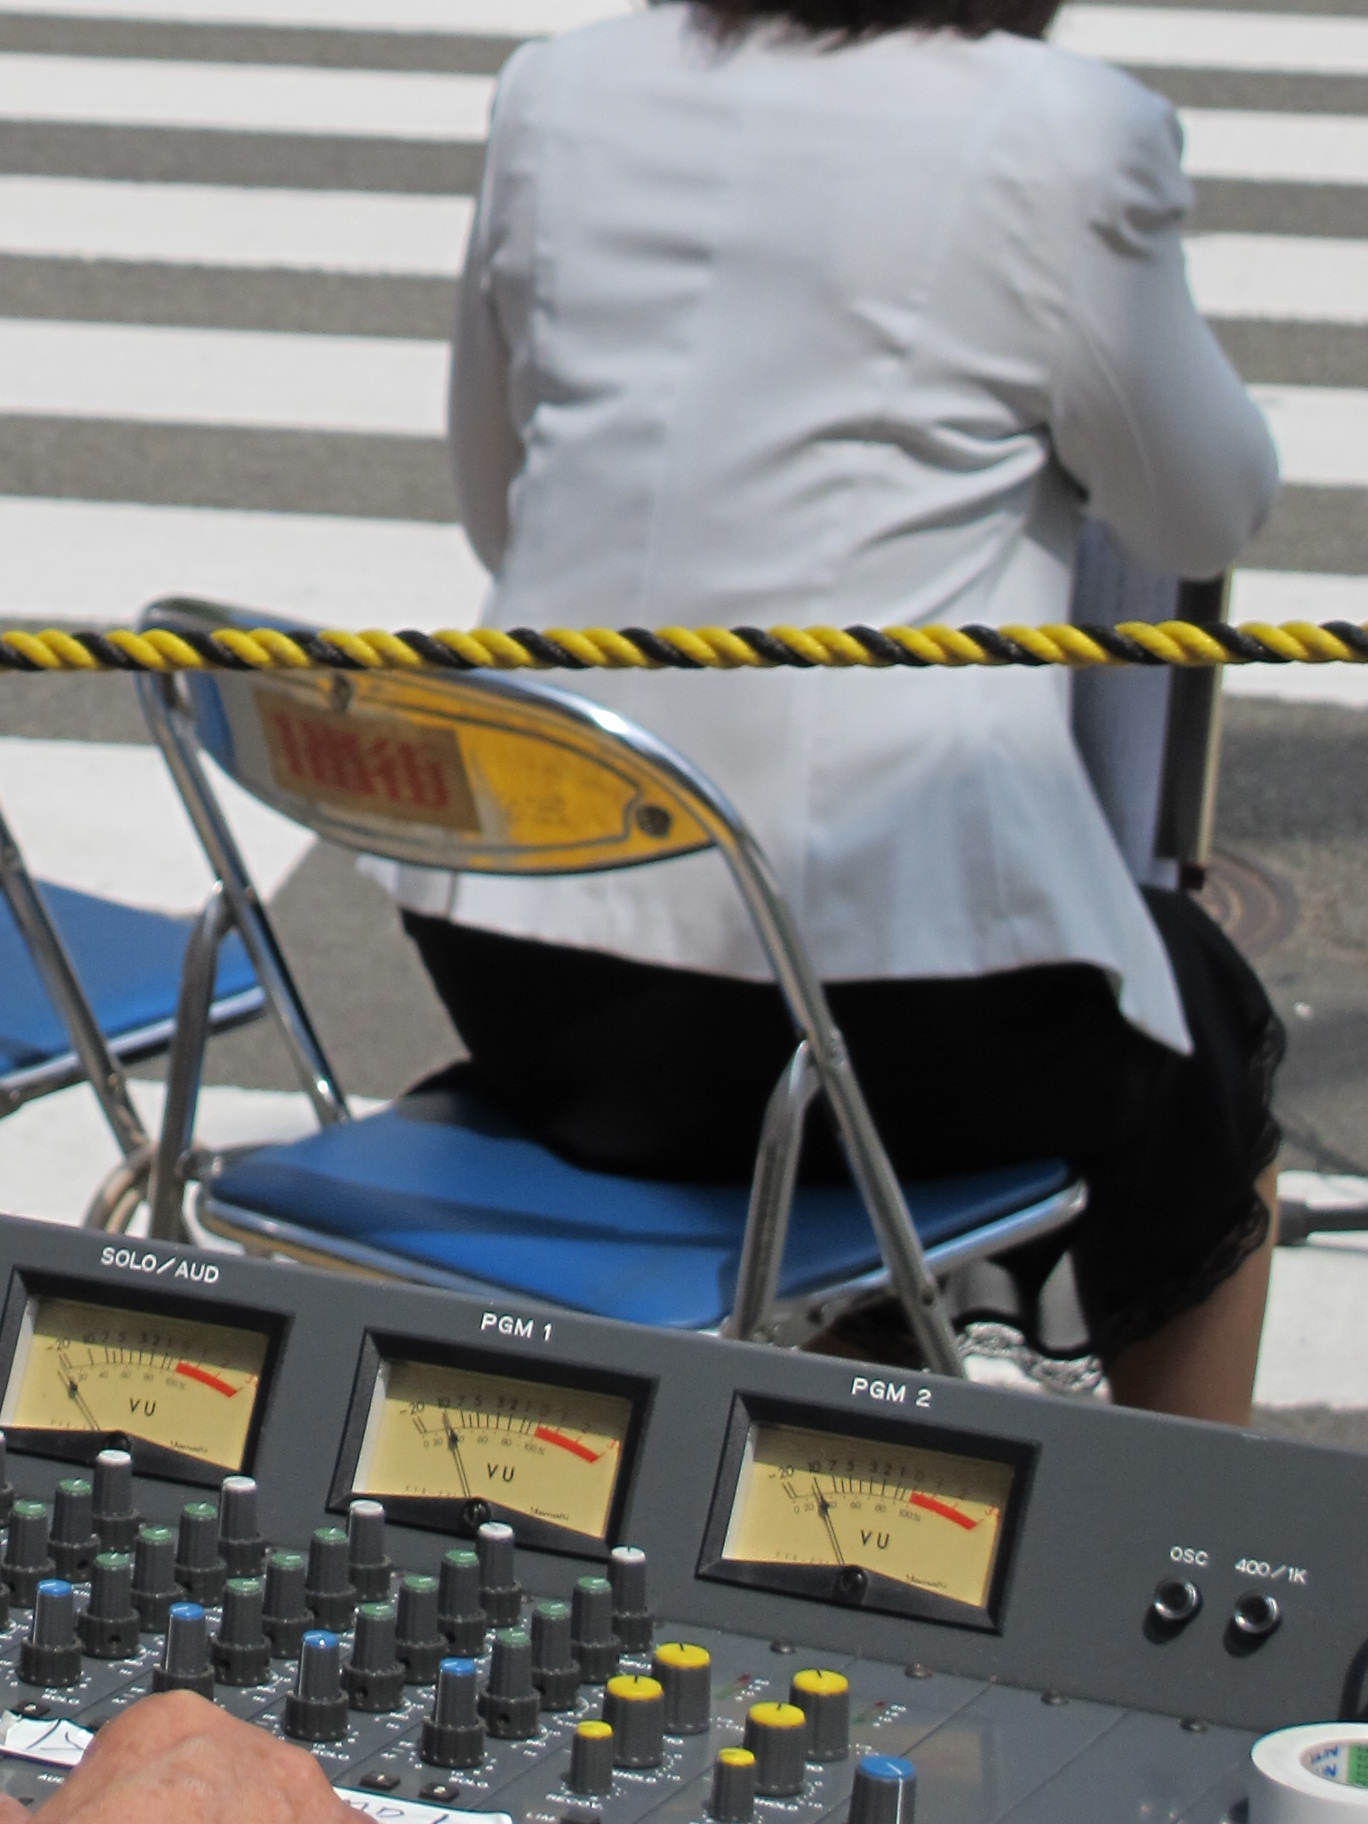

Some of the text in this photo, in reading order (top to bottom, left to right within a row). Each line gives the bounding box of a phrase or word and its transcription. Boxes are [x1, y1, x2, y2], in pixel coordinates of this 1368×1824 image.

[100, 1246, 220, 1284] SOLO/AUD
[480, 1311, 552, 1342] PGM 1
[851, 1376, 932, 1408] PGM 2
[130, 1398, 157, 1416] VU
[487, 1463, 515, 1483] VU
[860, 1529, 890, 1549] VU
[1170, 1545, 1210, 1567] OSC
[1234, 1557, 1309, 1586] 400/1K
